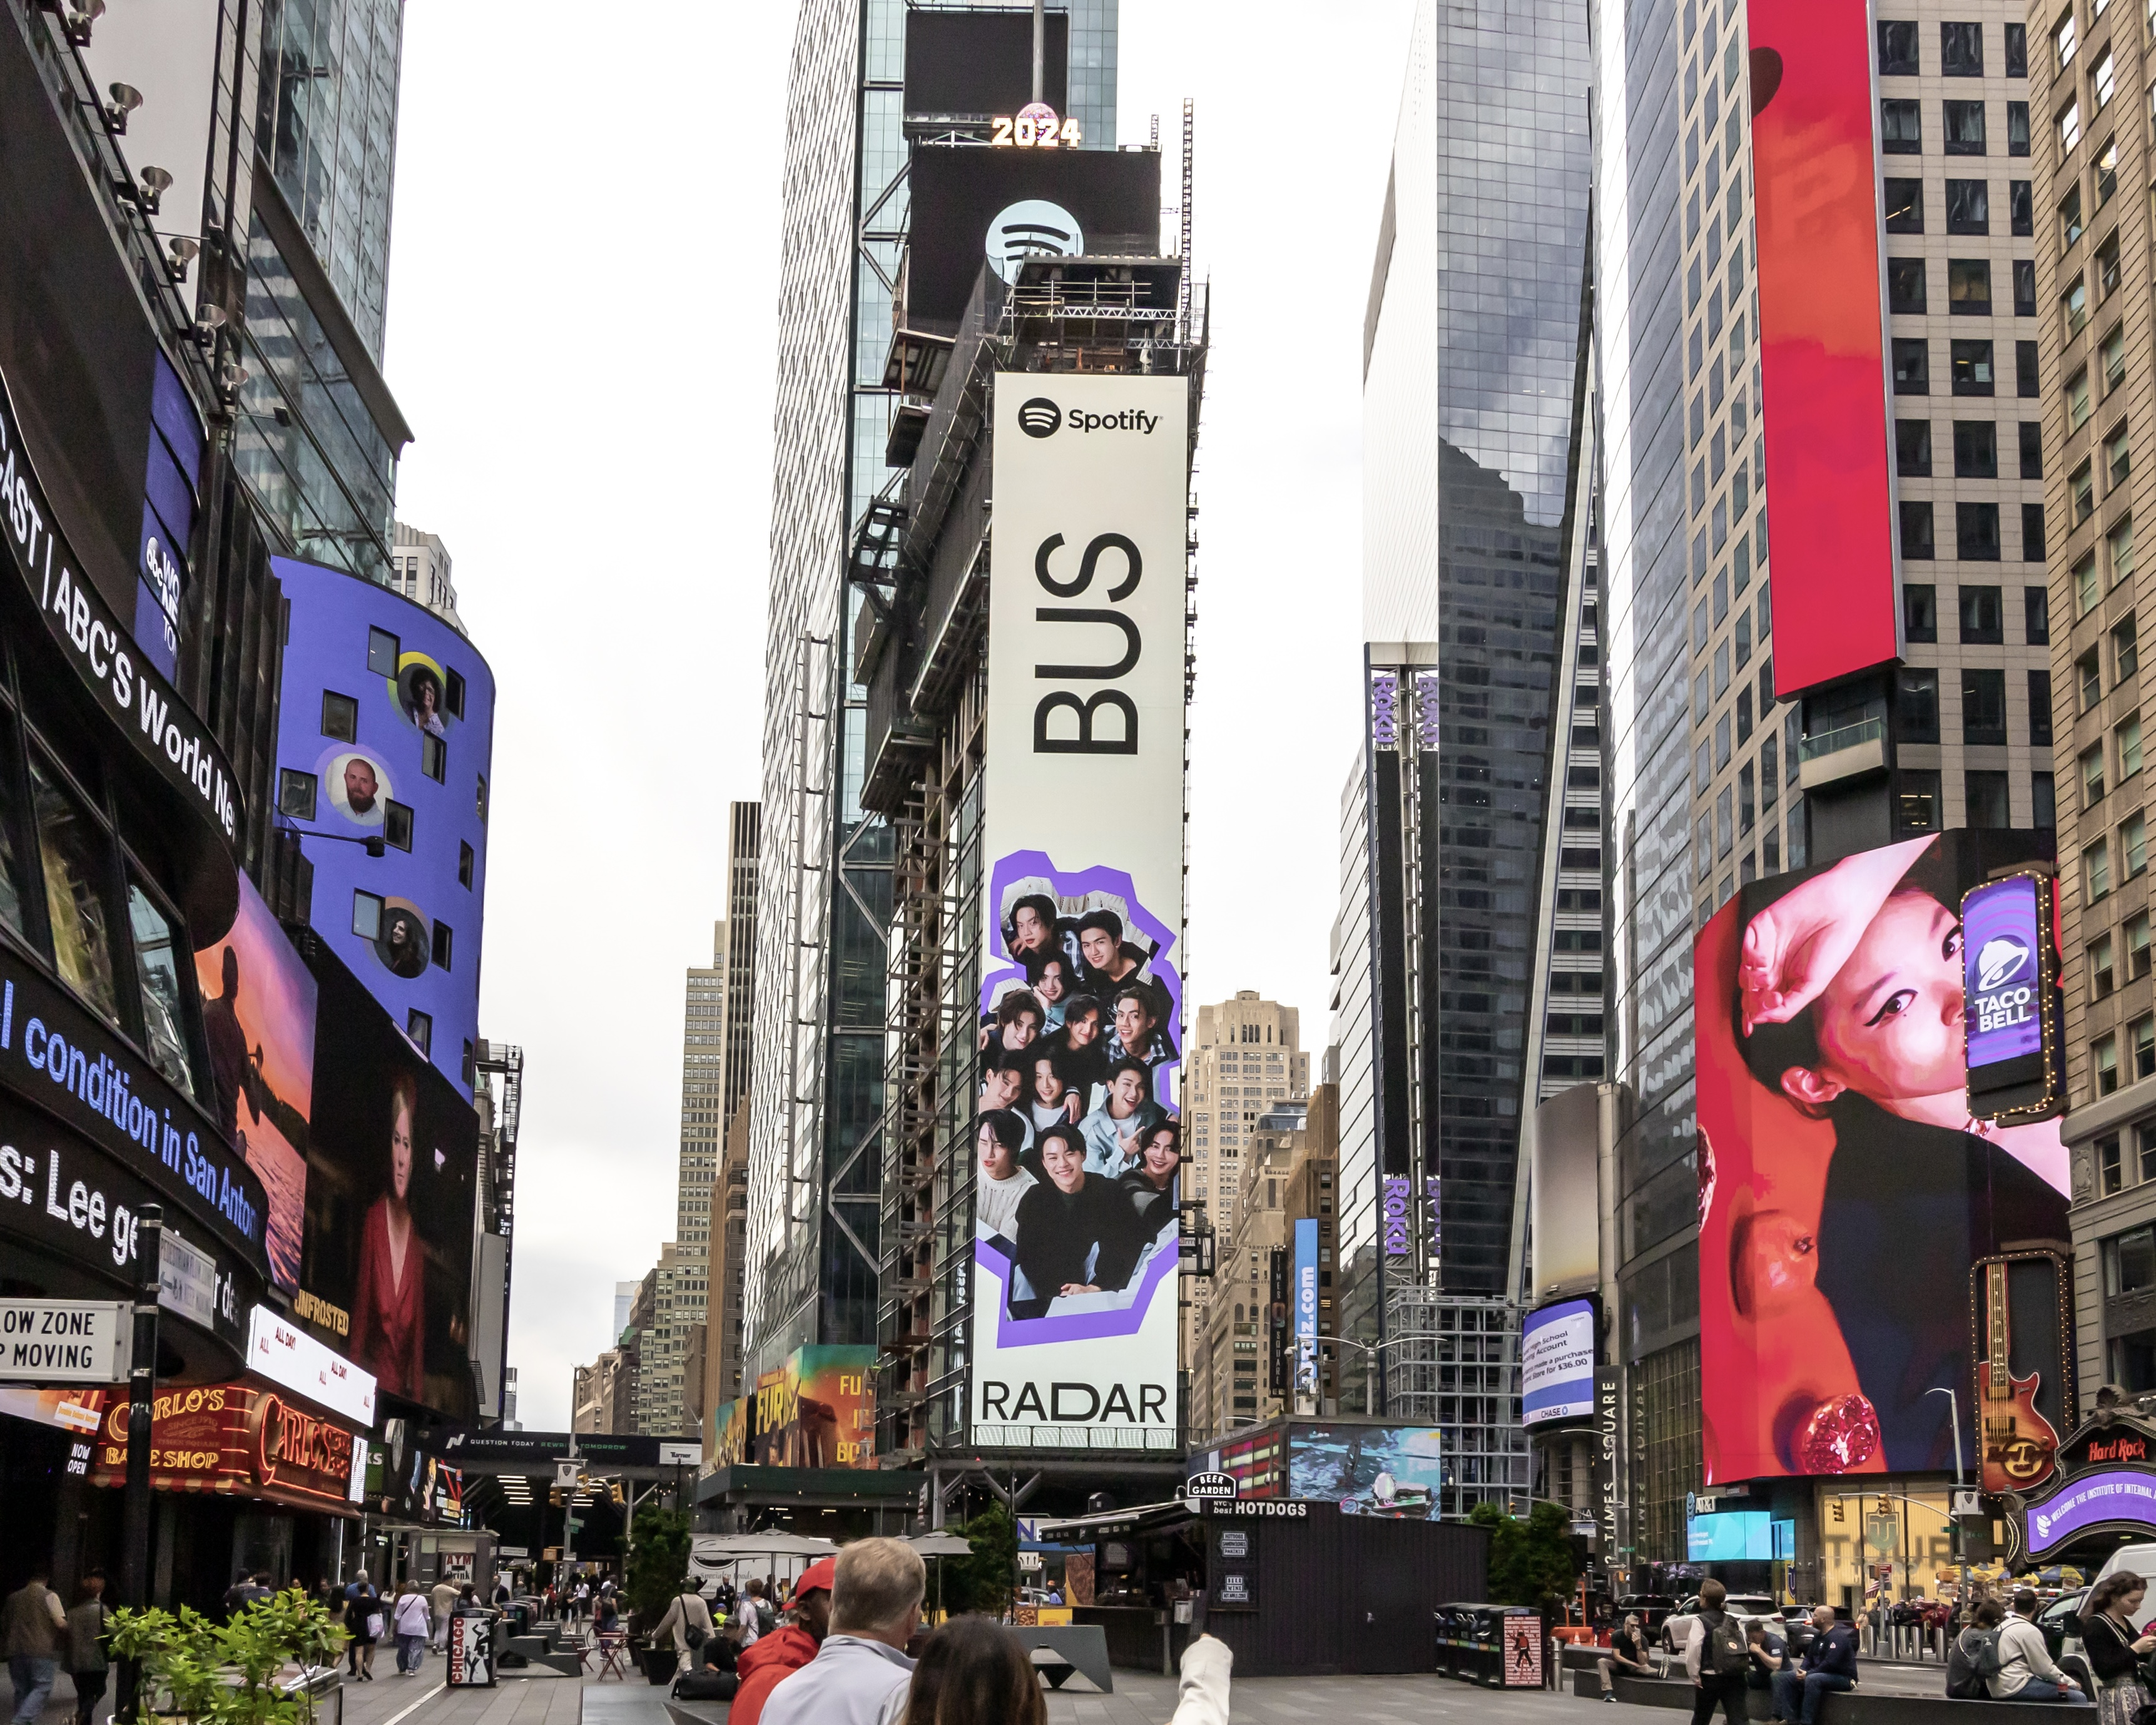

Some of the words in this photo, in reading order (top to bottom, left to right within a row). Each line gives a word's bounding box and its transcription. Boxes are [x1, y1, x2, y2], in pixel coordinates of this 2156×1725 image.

[992, 116, 1081, 147] 2024
[1067, 409, 1159, 435] Spotify
[0, 413, 43, 567] AST
[53, 567, 134, 709] ABC'S
[140, 676, 212, 801] World
[215, 768, 235, 844] Ne
[1033, 532, 1143, 755] BUS
[1974, 987, 2031, 1015] TACO
[1980, 1005, 2033, 1033] BELL
[25, 1017, 157, 1154] condition
[161, 1107, 181, 1174] in
[185, 1131, 217, 1206] San
[47, 1149, 106, 1238] Lee
[0, 1310, 34, 1333] OW
[41, 1311, 95, 1336] ZONE
[275, 1326, 284, 1345] ALL
[259, 1336, 269, 1355] ALL
[1536, 1340, 1568, 1355] Account
[1542, 1330, 1569, 1345] School
[13, 1343, 93, 1369] MOVING
[1547, 1366, 1556, 1375] for
[1558, 1358, 1588, 1371] $36.00
[1554, 1348, 1594, 1364] purchase
[318, 1370, 327, 1386] ALL
[982, 1380, 1167, 1423] RADAR
[1540, 1408, 1561, 1419] CHASE
[108, 1389, 226, 1442] CRLO'S
[1602, 1382, 1616, 1461] SQUARE
[71, 1443, 91, 1460] NOW
[105, 1447, 160, 1467] BAE
[163, 1450, 219, 1468] SHOP
[2088, 1440, 2117, 1462] Hard
[2118, 1437, 2146, 1462] Rock
[67, 1459, 87, 1475] OPEN
[1199, 1474, 1224, 1485] BEER
[1192, 1486, 1231, 1495] GARDEN
[2050, 1497, 2076, 1523] WELCOME
[2075, 1491, 2087, 1505] THE
[2087, 1483, 2115, 1500] INSTITUTE
[2115, 1483, 2123, 1493] OF
[2123, 1483, 2153, 1499] INTERNAL
[1213, 1506, 1233, 1514] best
[1235, 1501, 1307, 1517] HOTDOGS
[1603, 1482, 1615, 1542] TIMES
[1695, 1497, 1716, 1514] AT&T
[451, 1617, 465, 1684] CHICAGO
